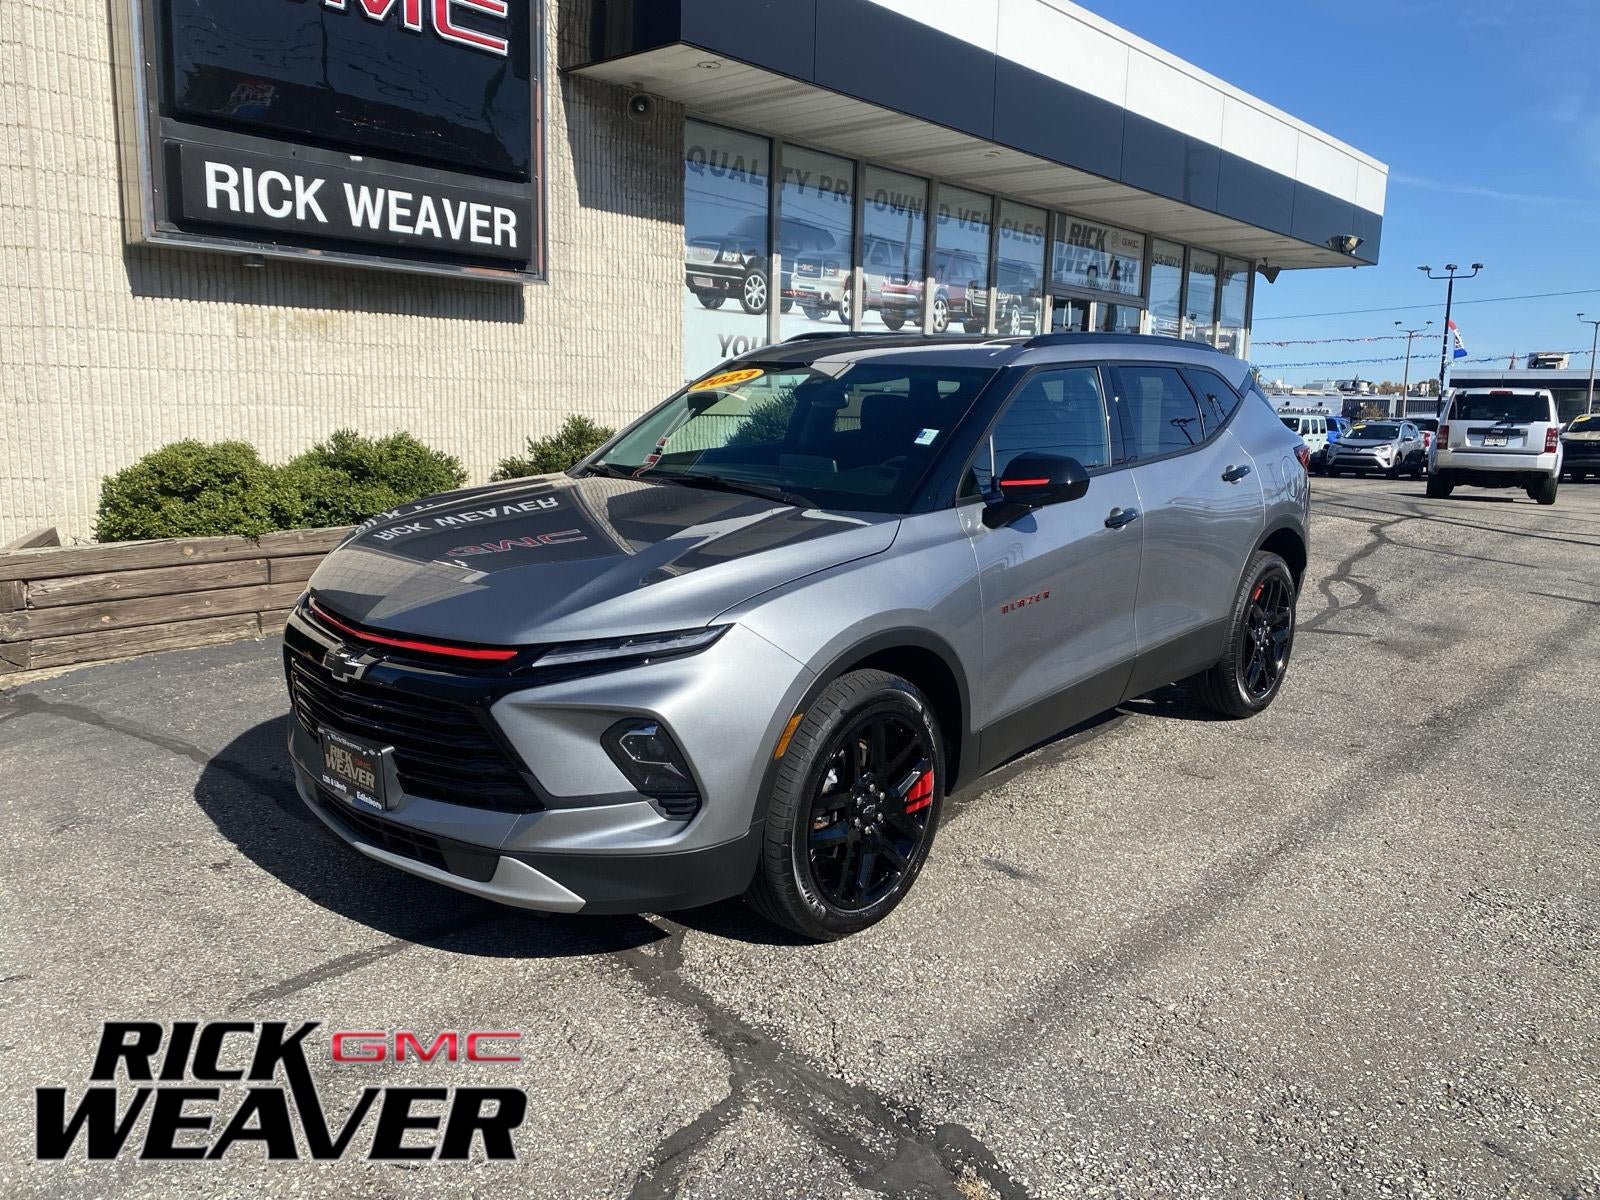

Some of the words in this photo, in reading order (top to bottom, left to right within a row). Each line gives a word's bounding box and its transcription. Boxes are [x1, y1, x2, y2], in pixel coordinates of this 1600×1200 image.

[686, 145, 812, 194] QUALTY
[204, 160, 328, 224] RICK
[343, 181, 518, 249] WEAVER
[1068, 222, 1109, 253] RICK
[1054, 244, 1137, 283] WEAVER
[1001, 590, 1050, 614] BLAZER
[325, 753, 376, 790] WEAVER
[330, 744, 352, 762] RICK
